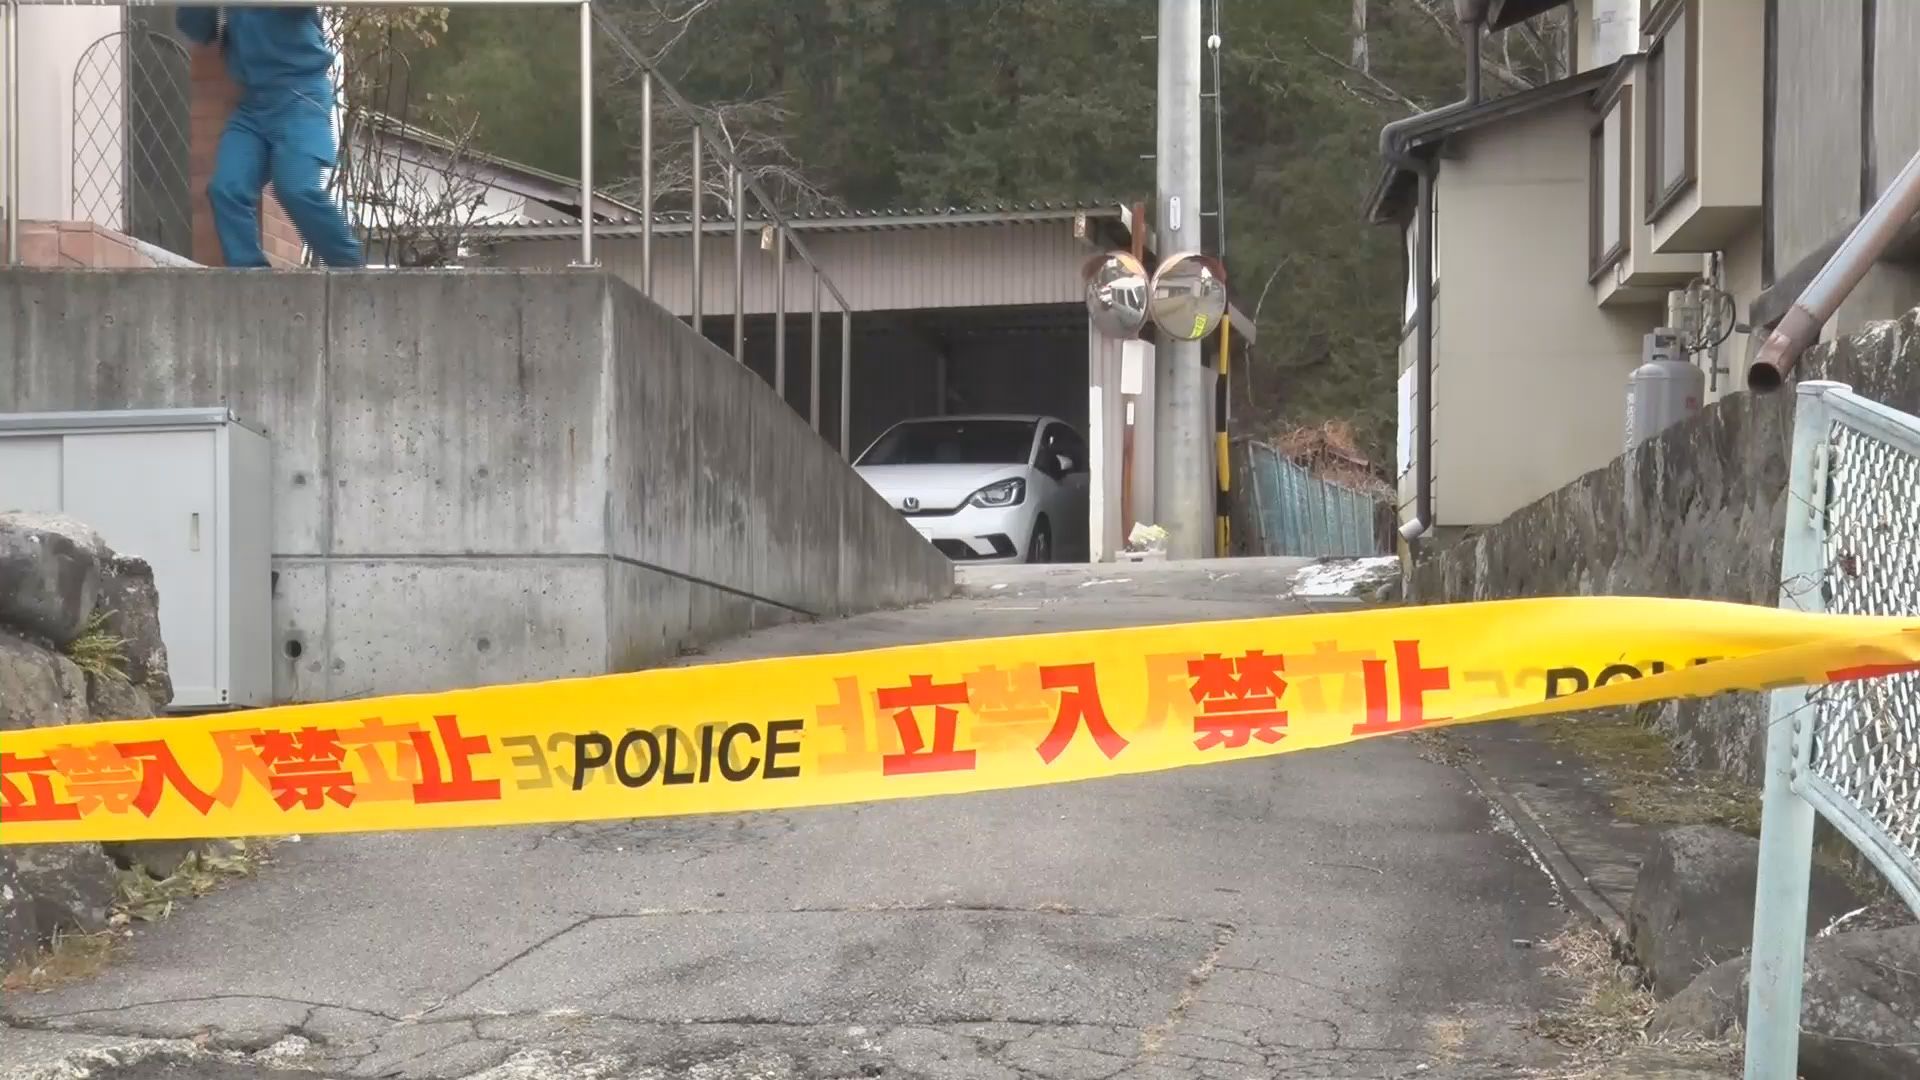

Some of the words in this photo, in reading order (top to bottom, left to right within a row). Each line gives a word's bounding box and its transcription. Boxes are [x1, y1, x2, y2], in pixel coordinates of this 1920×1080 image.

[572, 719, 805, 790] POLICE
[876, 640, 1452, 775] 立入禁止
[0, 714, 502, 823] 立入禁止
